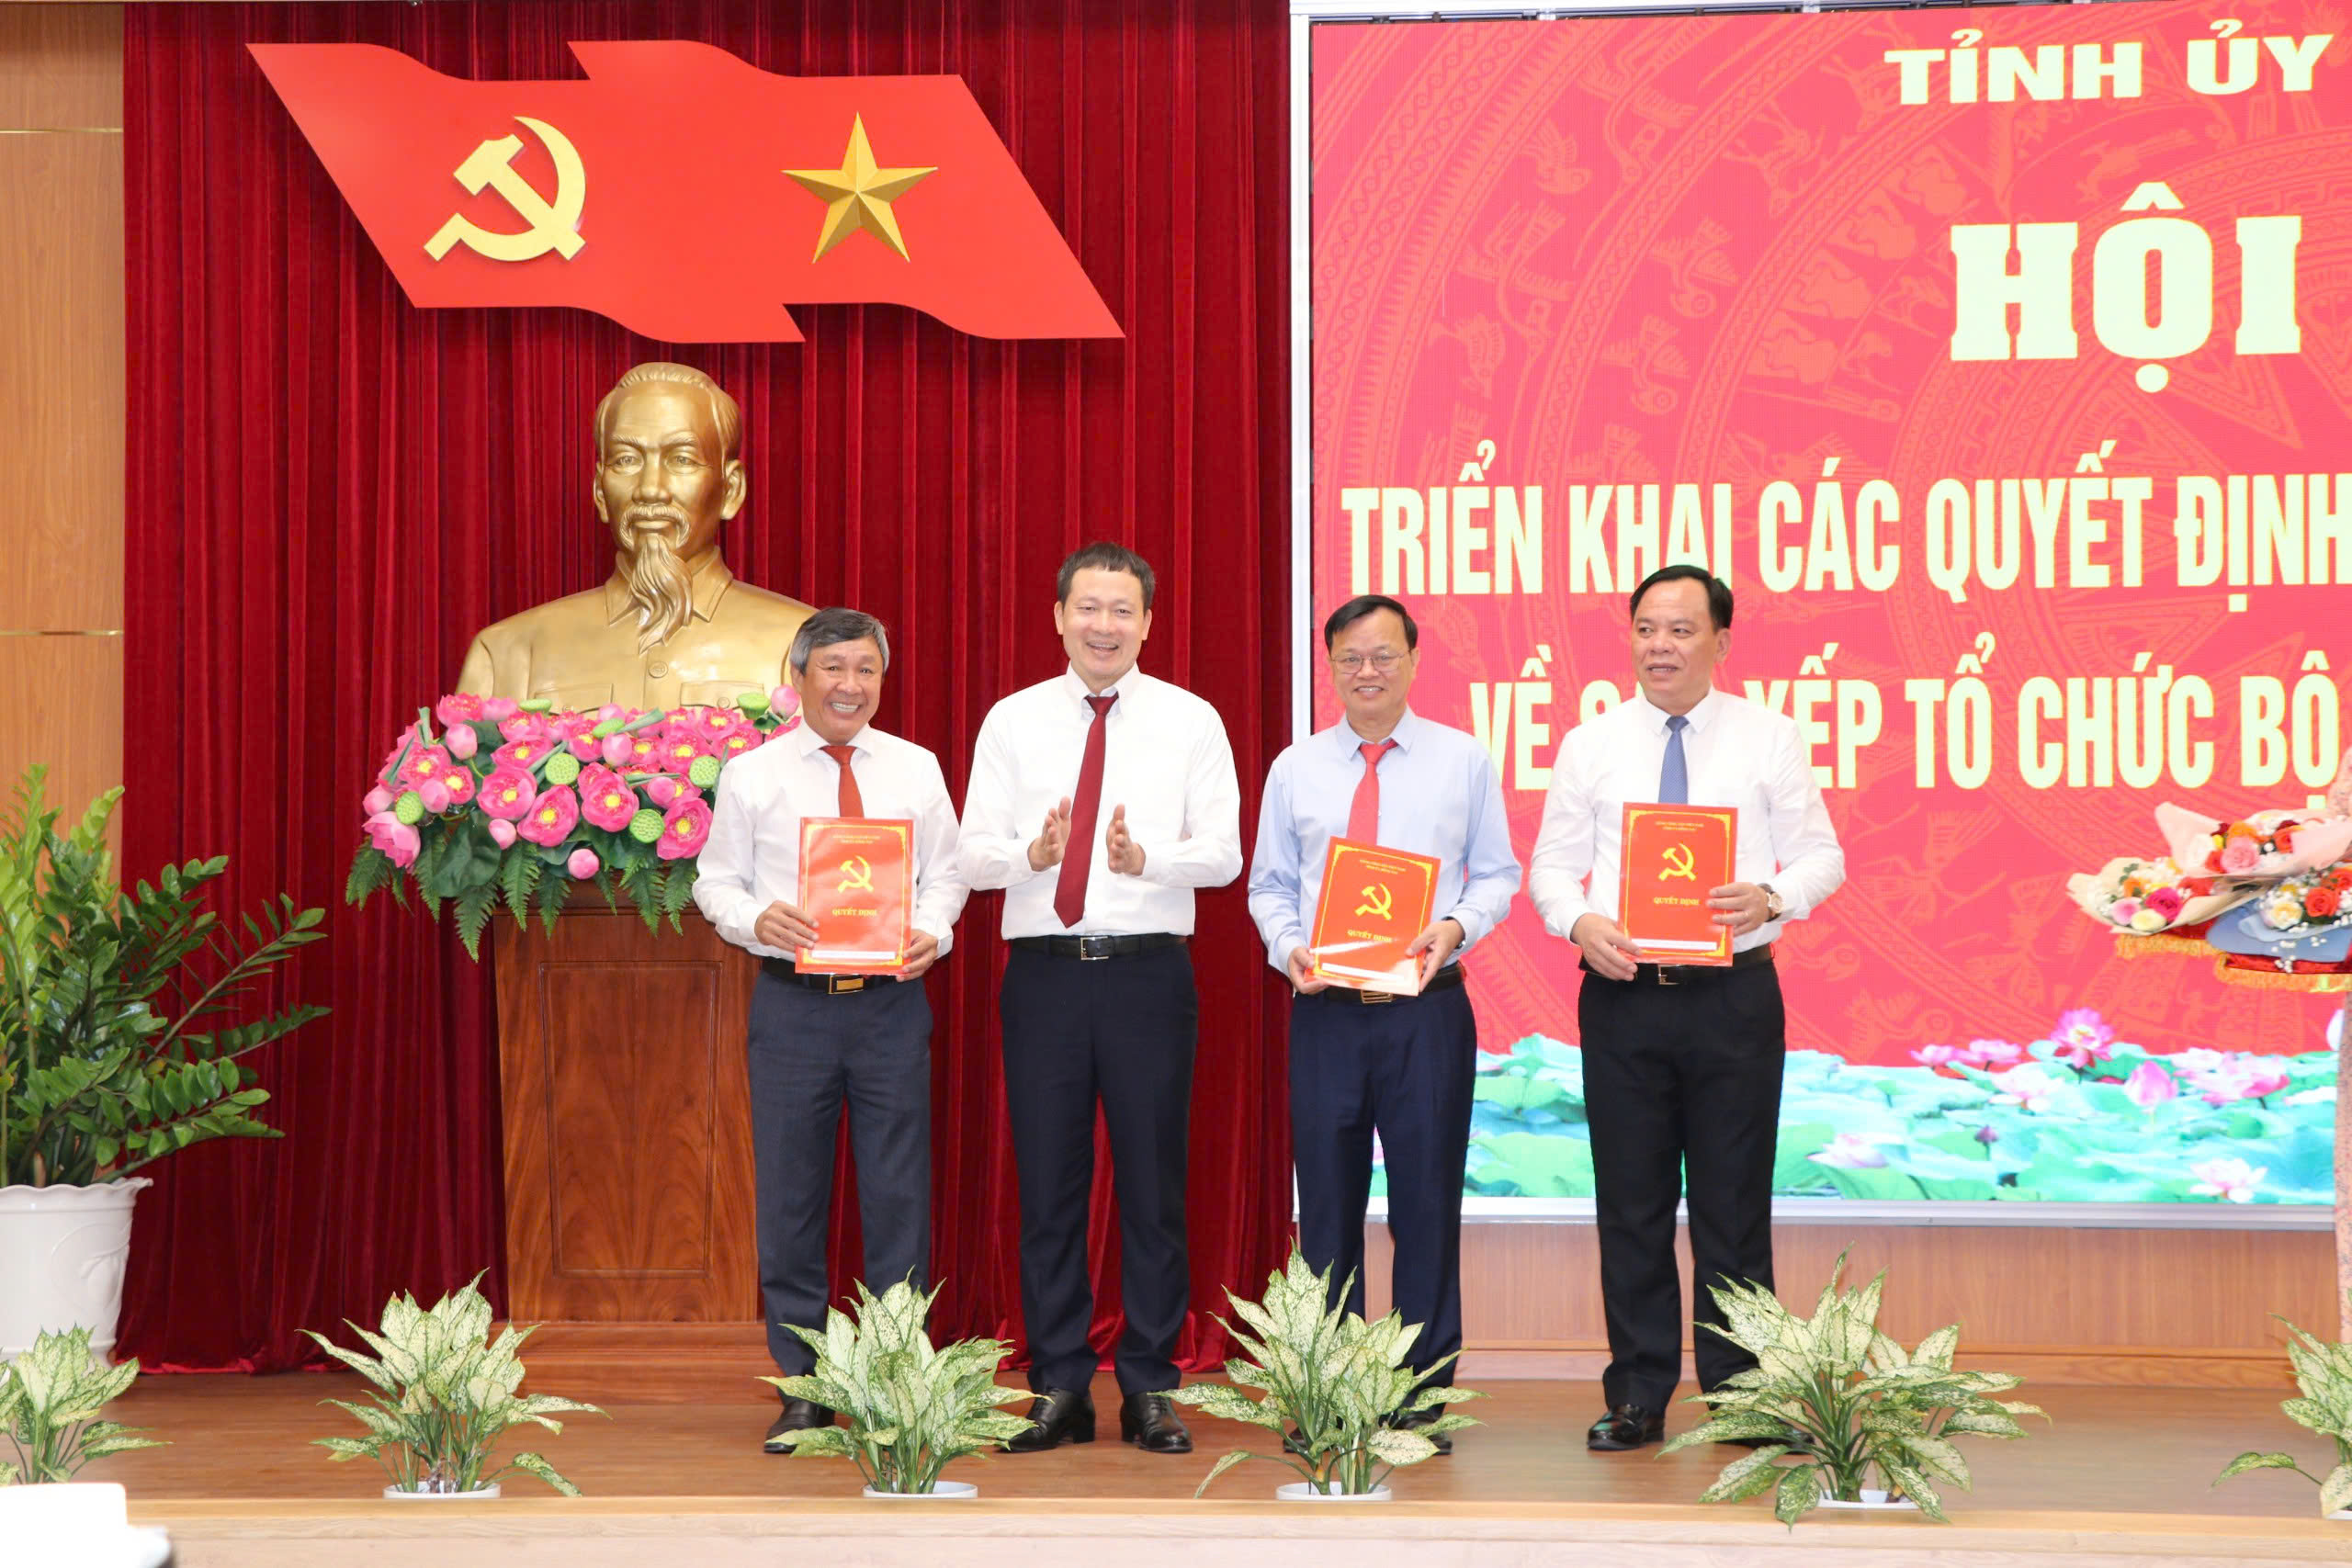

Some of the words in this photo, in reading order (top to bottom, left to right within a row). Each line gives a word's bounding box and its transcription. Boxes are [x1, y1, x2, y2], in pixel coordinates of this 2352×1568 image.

[1884, 28, 2143, 105] TỈNH
[2188, 18, 2334, 95] ỦY
[1951, 181, 2301, 393] HỘI
[1341, 439, 1543, 595] TRIỂN
[1569, 483, 1732, 593] KHAI
[1758, 457, 1900, 592] CÁC
[1927, 440, 2153, 603] QUYẾT
[2174, 473, 2352, 612] ĐỊNH
[1470, 644, 1553, 790] VỀ
[1905, 632, 1992, 789] TỔ
[2018, 651, 2214, 789] CHỨC
[2241, 650, 2340, 810] BỘ
